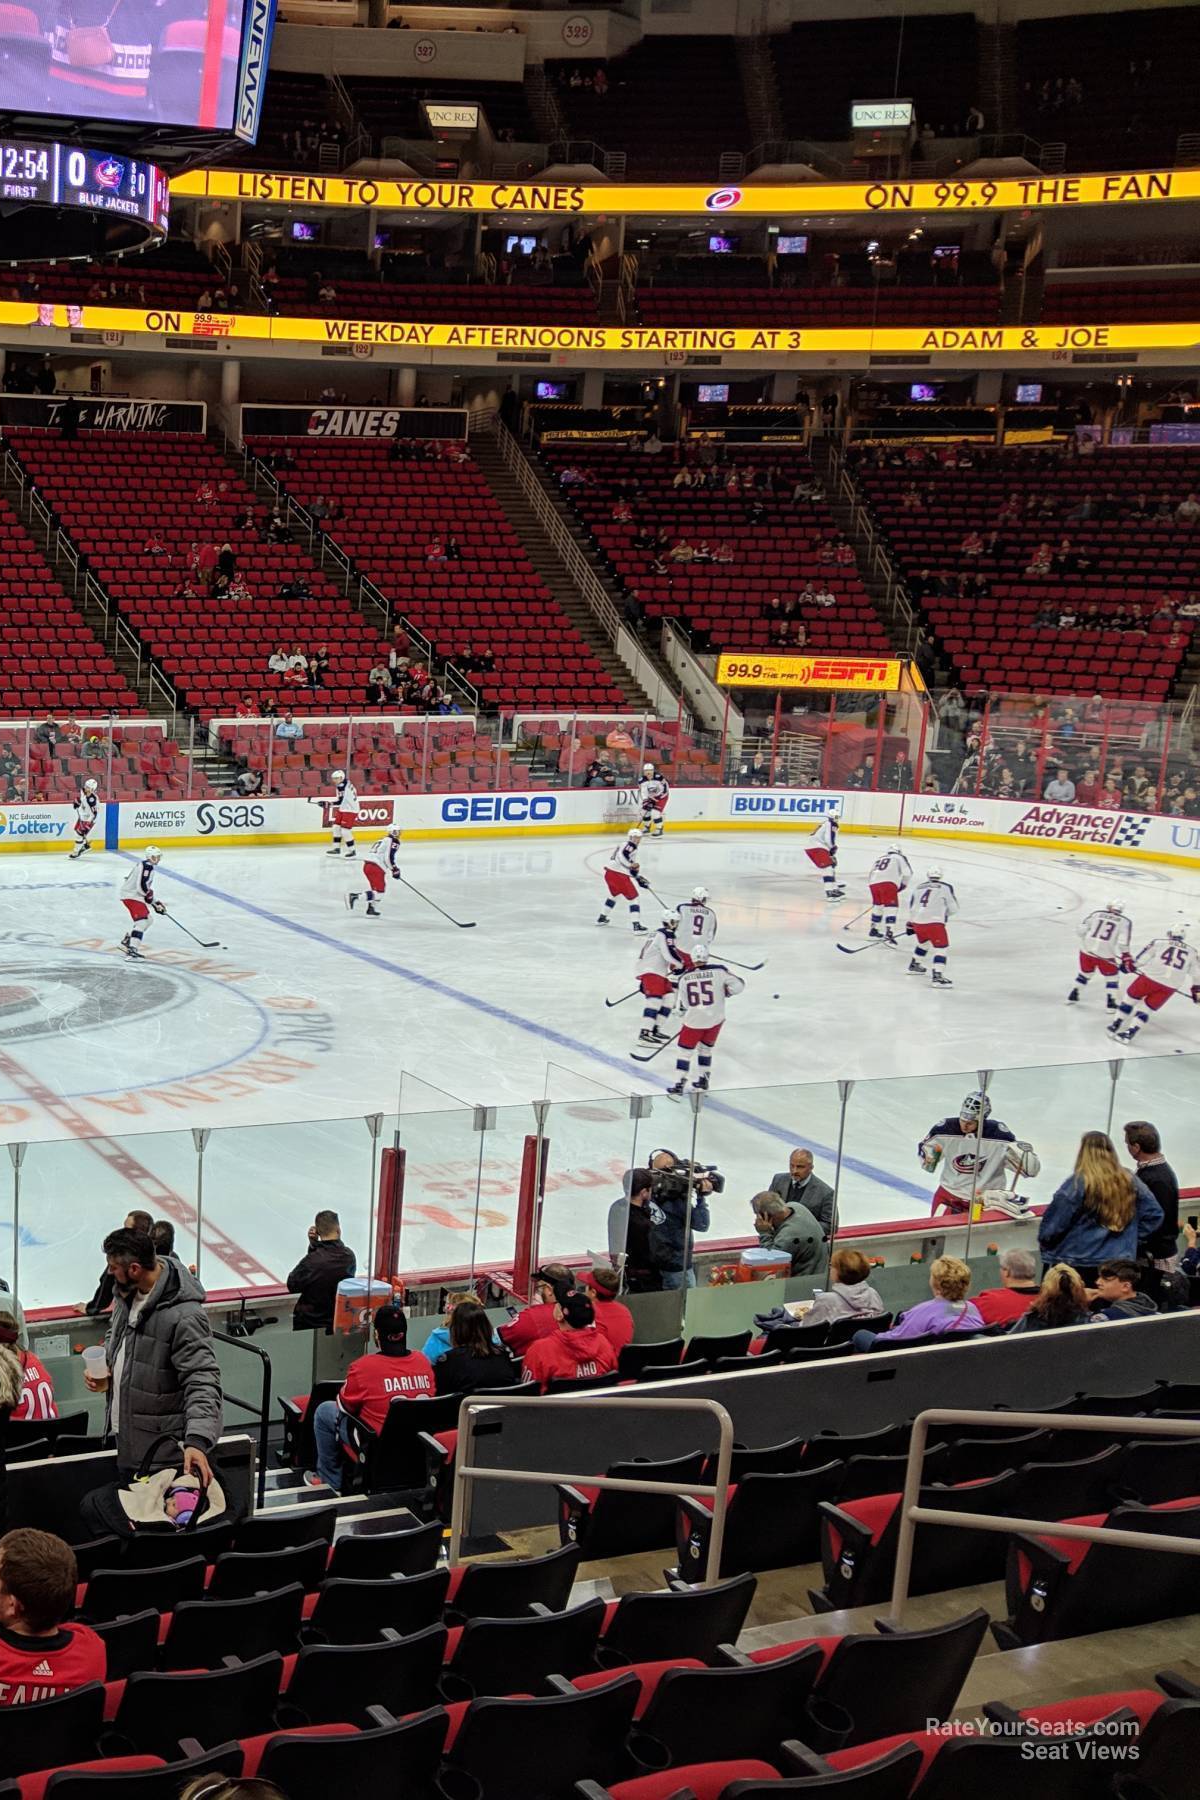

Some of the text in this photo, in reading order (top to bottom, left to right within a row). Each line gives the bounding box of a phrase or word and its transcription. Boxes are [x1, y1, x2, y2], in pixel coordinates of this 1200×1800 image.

[566, 25, 589, 38] 328
[417, 46, 433, 57] 327
[428, 111, 476, 122] UNC REX
[854, 110, 910, 121] UNC REX
[68, 152, 86, 187] 0
[4, 184, 38, 198] FIRST
[138, 173, 145, 195] 0
[238, 173, 585, 211] LISTEN TO YOUR CANES
[864, 173, 1172, 210] ON 99.9 THE FAN
[79, 192, 139, 214] BLUE JACKETS
[146, 311, 181, 332] ON
[193, 314, 213, 324] 99.9
[105, 331, 120, 342] 121
[325, 321, 802, 350] WEEKDAY AFTERNOONS STARTING AT 3
[922, 327, 1110, 349] ADAM & JOE
[355, 344, 369, 354] 122
[1051, 351, 1068, 361] 124
[46, 400, 172, 431] TE WARNING
[307, 409, 401, 437] CANES
[726, 662, 763, 679] 99.9
[811, 660, 888, 682] ESPN
[135, 810, 186, 820] ANALYTICS
[441, 796, 557, 823] GEICO
[734, 796, 840, 814] BUD LIGHT
[9, 812, 52, 821] NC Education
[134, 818, 186, 829] POWERED BY
[1021, 806, 1115, 830] Advance
[8, 819, 66, 837] Lottery
[1008, 821, 1109, 844] Auto Parts
[919, 888, 932, 908] 4
[692, 914, 705, 936] 9
[1091, 919, 1117, 942] 13
[1160, 946, 1189, 970] 45
[686, 980, 715, 1007] 65
[81, 1011, 335, 1116] PNC ARENA
[576, 1361, 598, 1378] AHO
[384, 1374, 431, 1393] DARLING
